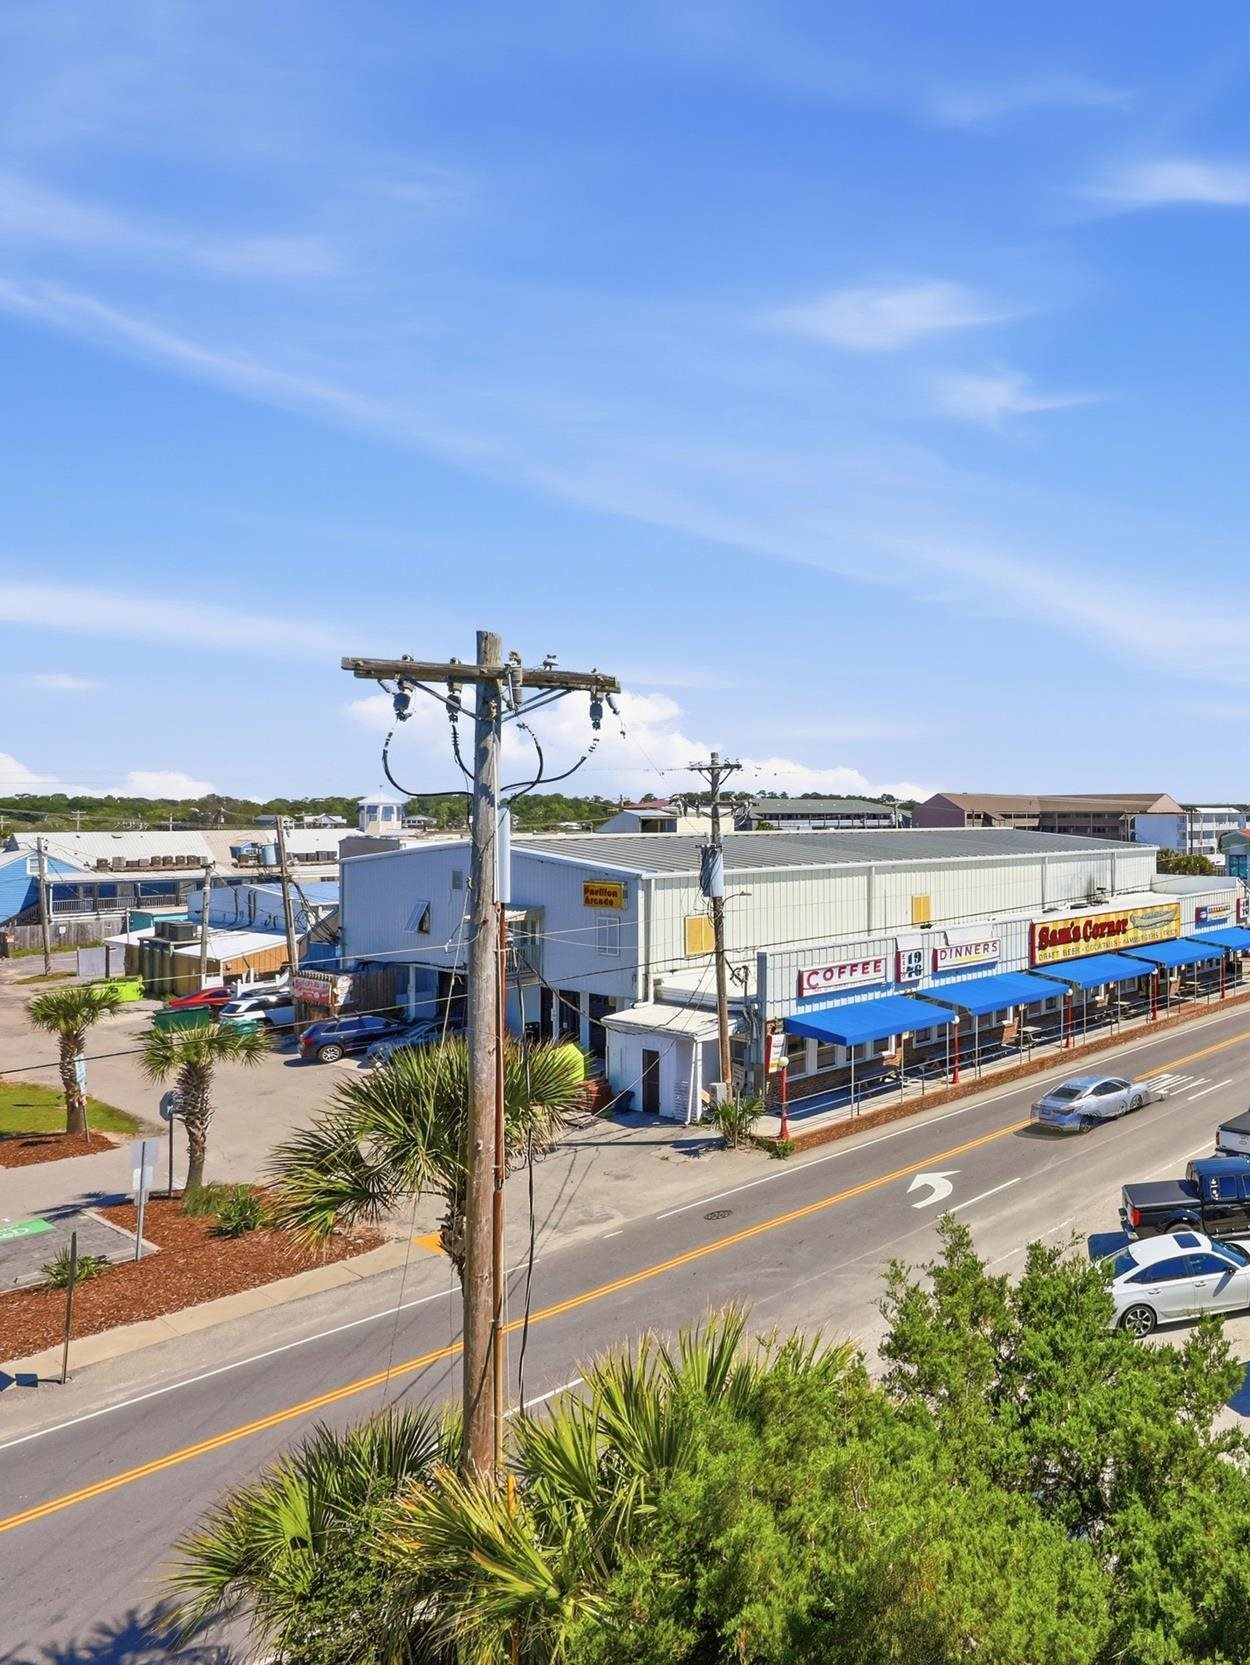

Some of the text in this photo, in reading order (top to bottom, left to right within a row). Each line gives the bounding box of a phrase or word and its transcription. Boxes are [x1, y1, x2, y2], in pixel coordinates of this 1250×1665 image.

[584, 886, 618, 898] Pavilion
[584, 896, 614, 906] Arcade
[1038, 918, 1129, 951] Sam's Corner
[908, 951, 922, 965] 19
[940, 942, 998, 961] DINNERS
[1039, 950, 1060, 961] DRAFT
[1063, 947, 1080, 957] BEER
[807, 960, 882, 989] COFFEE
